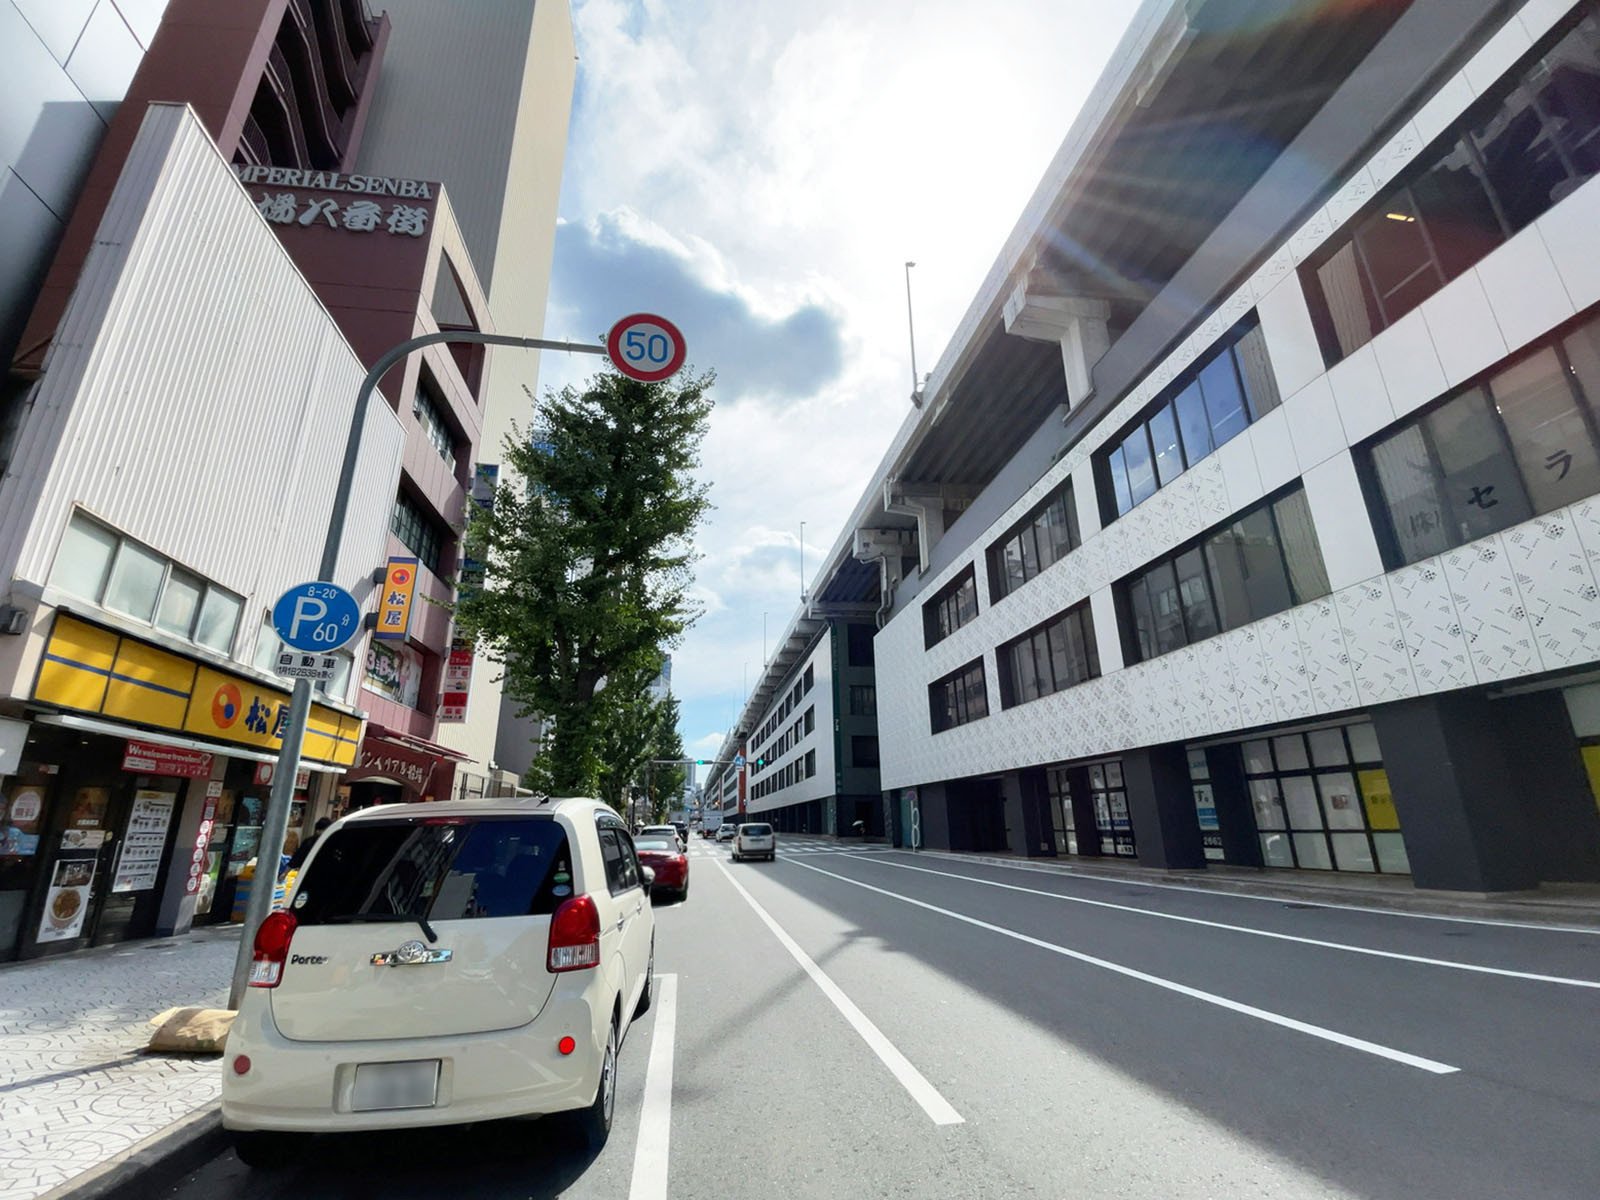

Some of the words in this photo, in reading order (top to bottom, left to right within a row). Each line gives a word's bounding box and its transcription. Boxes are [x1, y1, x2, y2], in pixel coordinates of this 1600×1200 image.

[626, 330, 668, 363] 50
[307, 586, 337, 600] 8-20
[289, 596, 328, 639] P
[384, 590, 406, 626] 松屋
[312, 622, 338, 643] 60
[279, 654, 337, 669] 自動車
